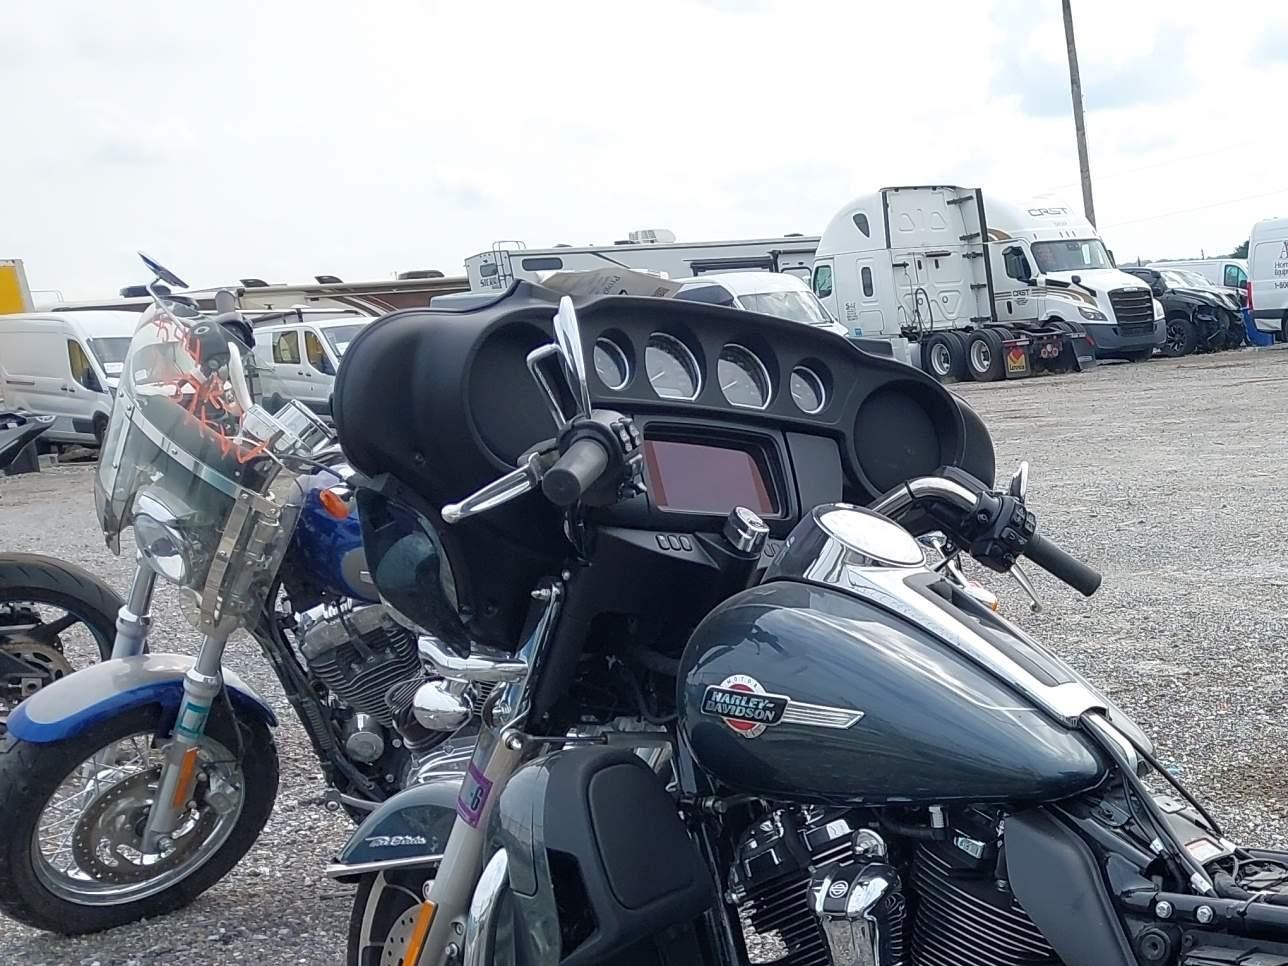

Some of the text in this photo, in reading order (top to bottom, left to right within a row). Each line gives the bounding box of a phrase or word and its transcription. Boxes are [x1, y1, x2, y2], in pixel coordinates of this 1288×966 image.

[1028, 207, 1068, 217] CRST
[1012, 288, 1030, 297] CRST
[711, 691, 775, 709] HARLEY-
[705, 700, 776, 721] DAVIDSON
